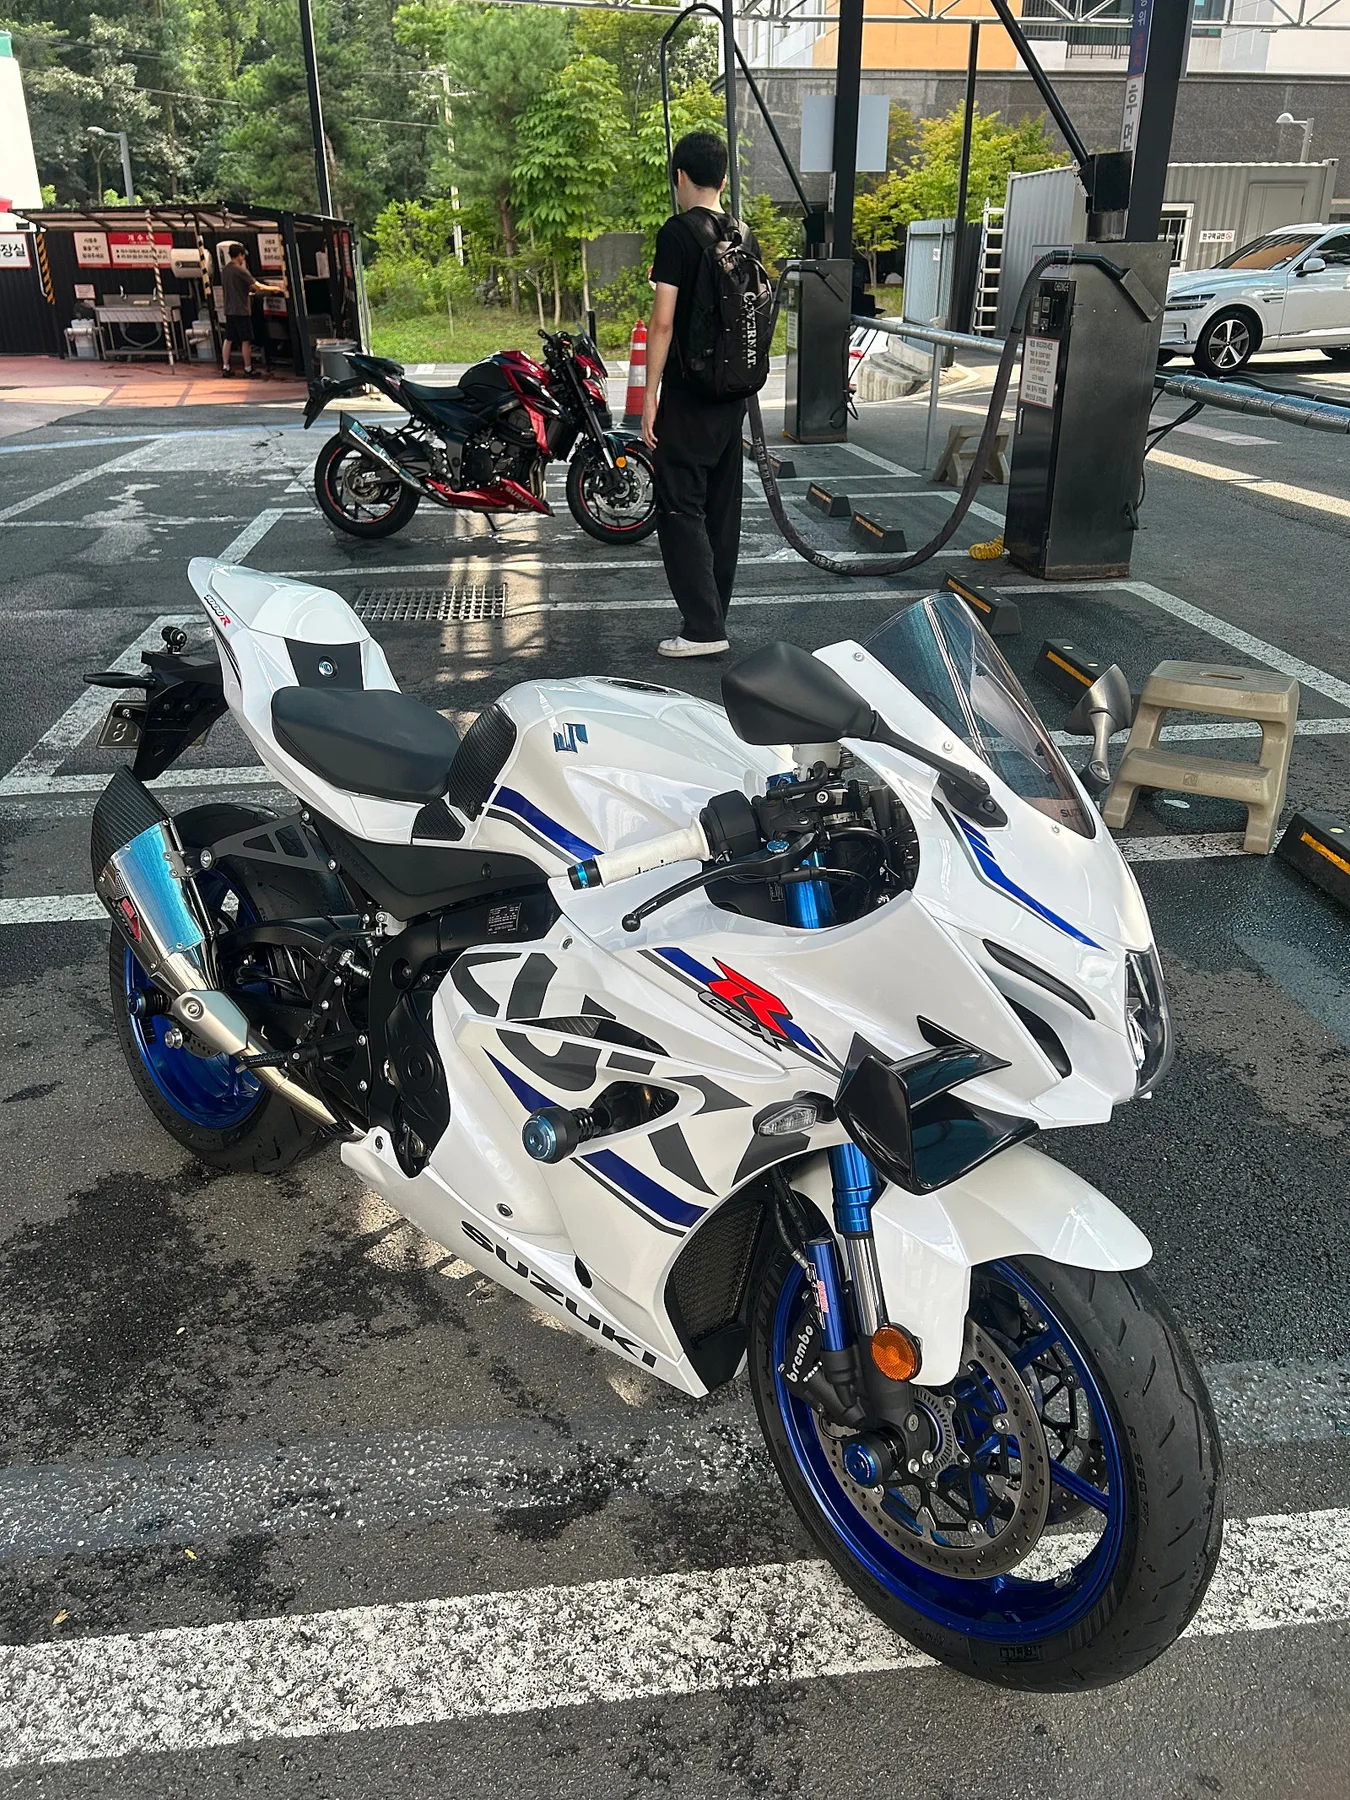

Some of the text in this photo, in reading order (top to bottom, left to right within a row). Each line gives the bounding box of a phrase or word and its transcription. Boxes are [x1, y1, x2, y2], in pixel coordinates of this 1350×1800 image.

[0, 243, 26, 257] 장실
[461, 1220, 657, 1369] SUZUKI
[786, 1324, 814, 1384] brembo
